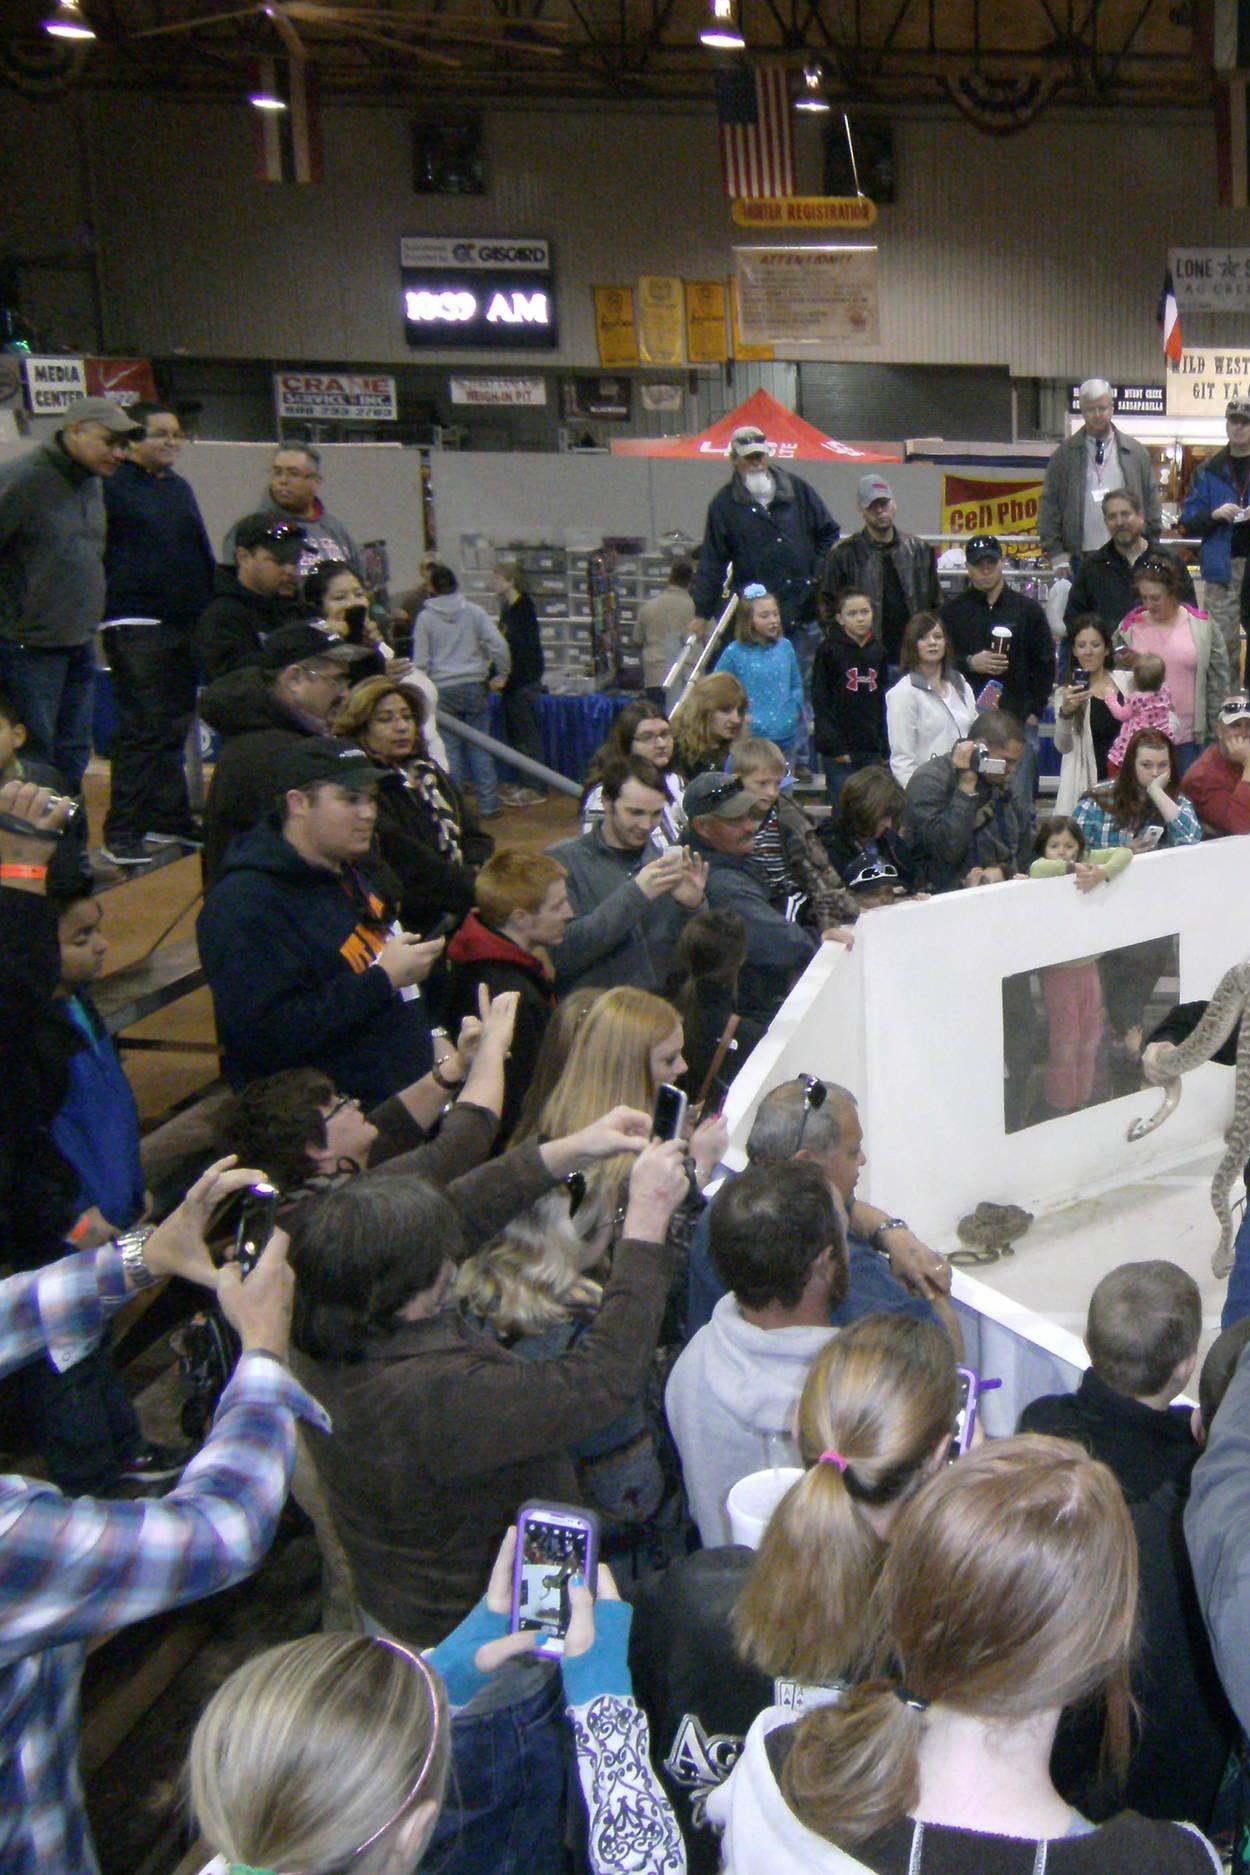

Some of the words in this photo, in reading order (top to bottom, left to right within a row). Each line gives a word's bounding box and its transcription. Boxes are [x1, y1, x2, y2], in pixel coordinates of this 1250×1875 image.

[1176, 258, 1213, 279] LONE
[486, 293, 549, 323] AM
[34, 365, 81, 383] MEDIA
[1215, 356, 1250, 375] WEST
[1192, 382, 1215, 400] GIT
[950, 503, 993, 534] Cell
[997, 498, 1038, 525] Pho
